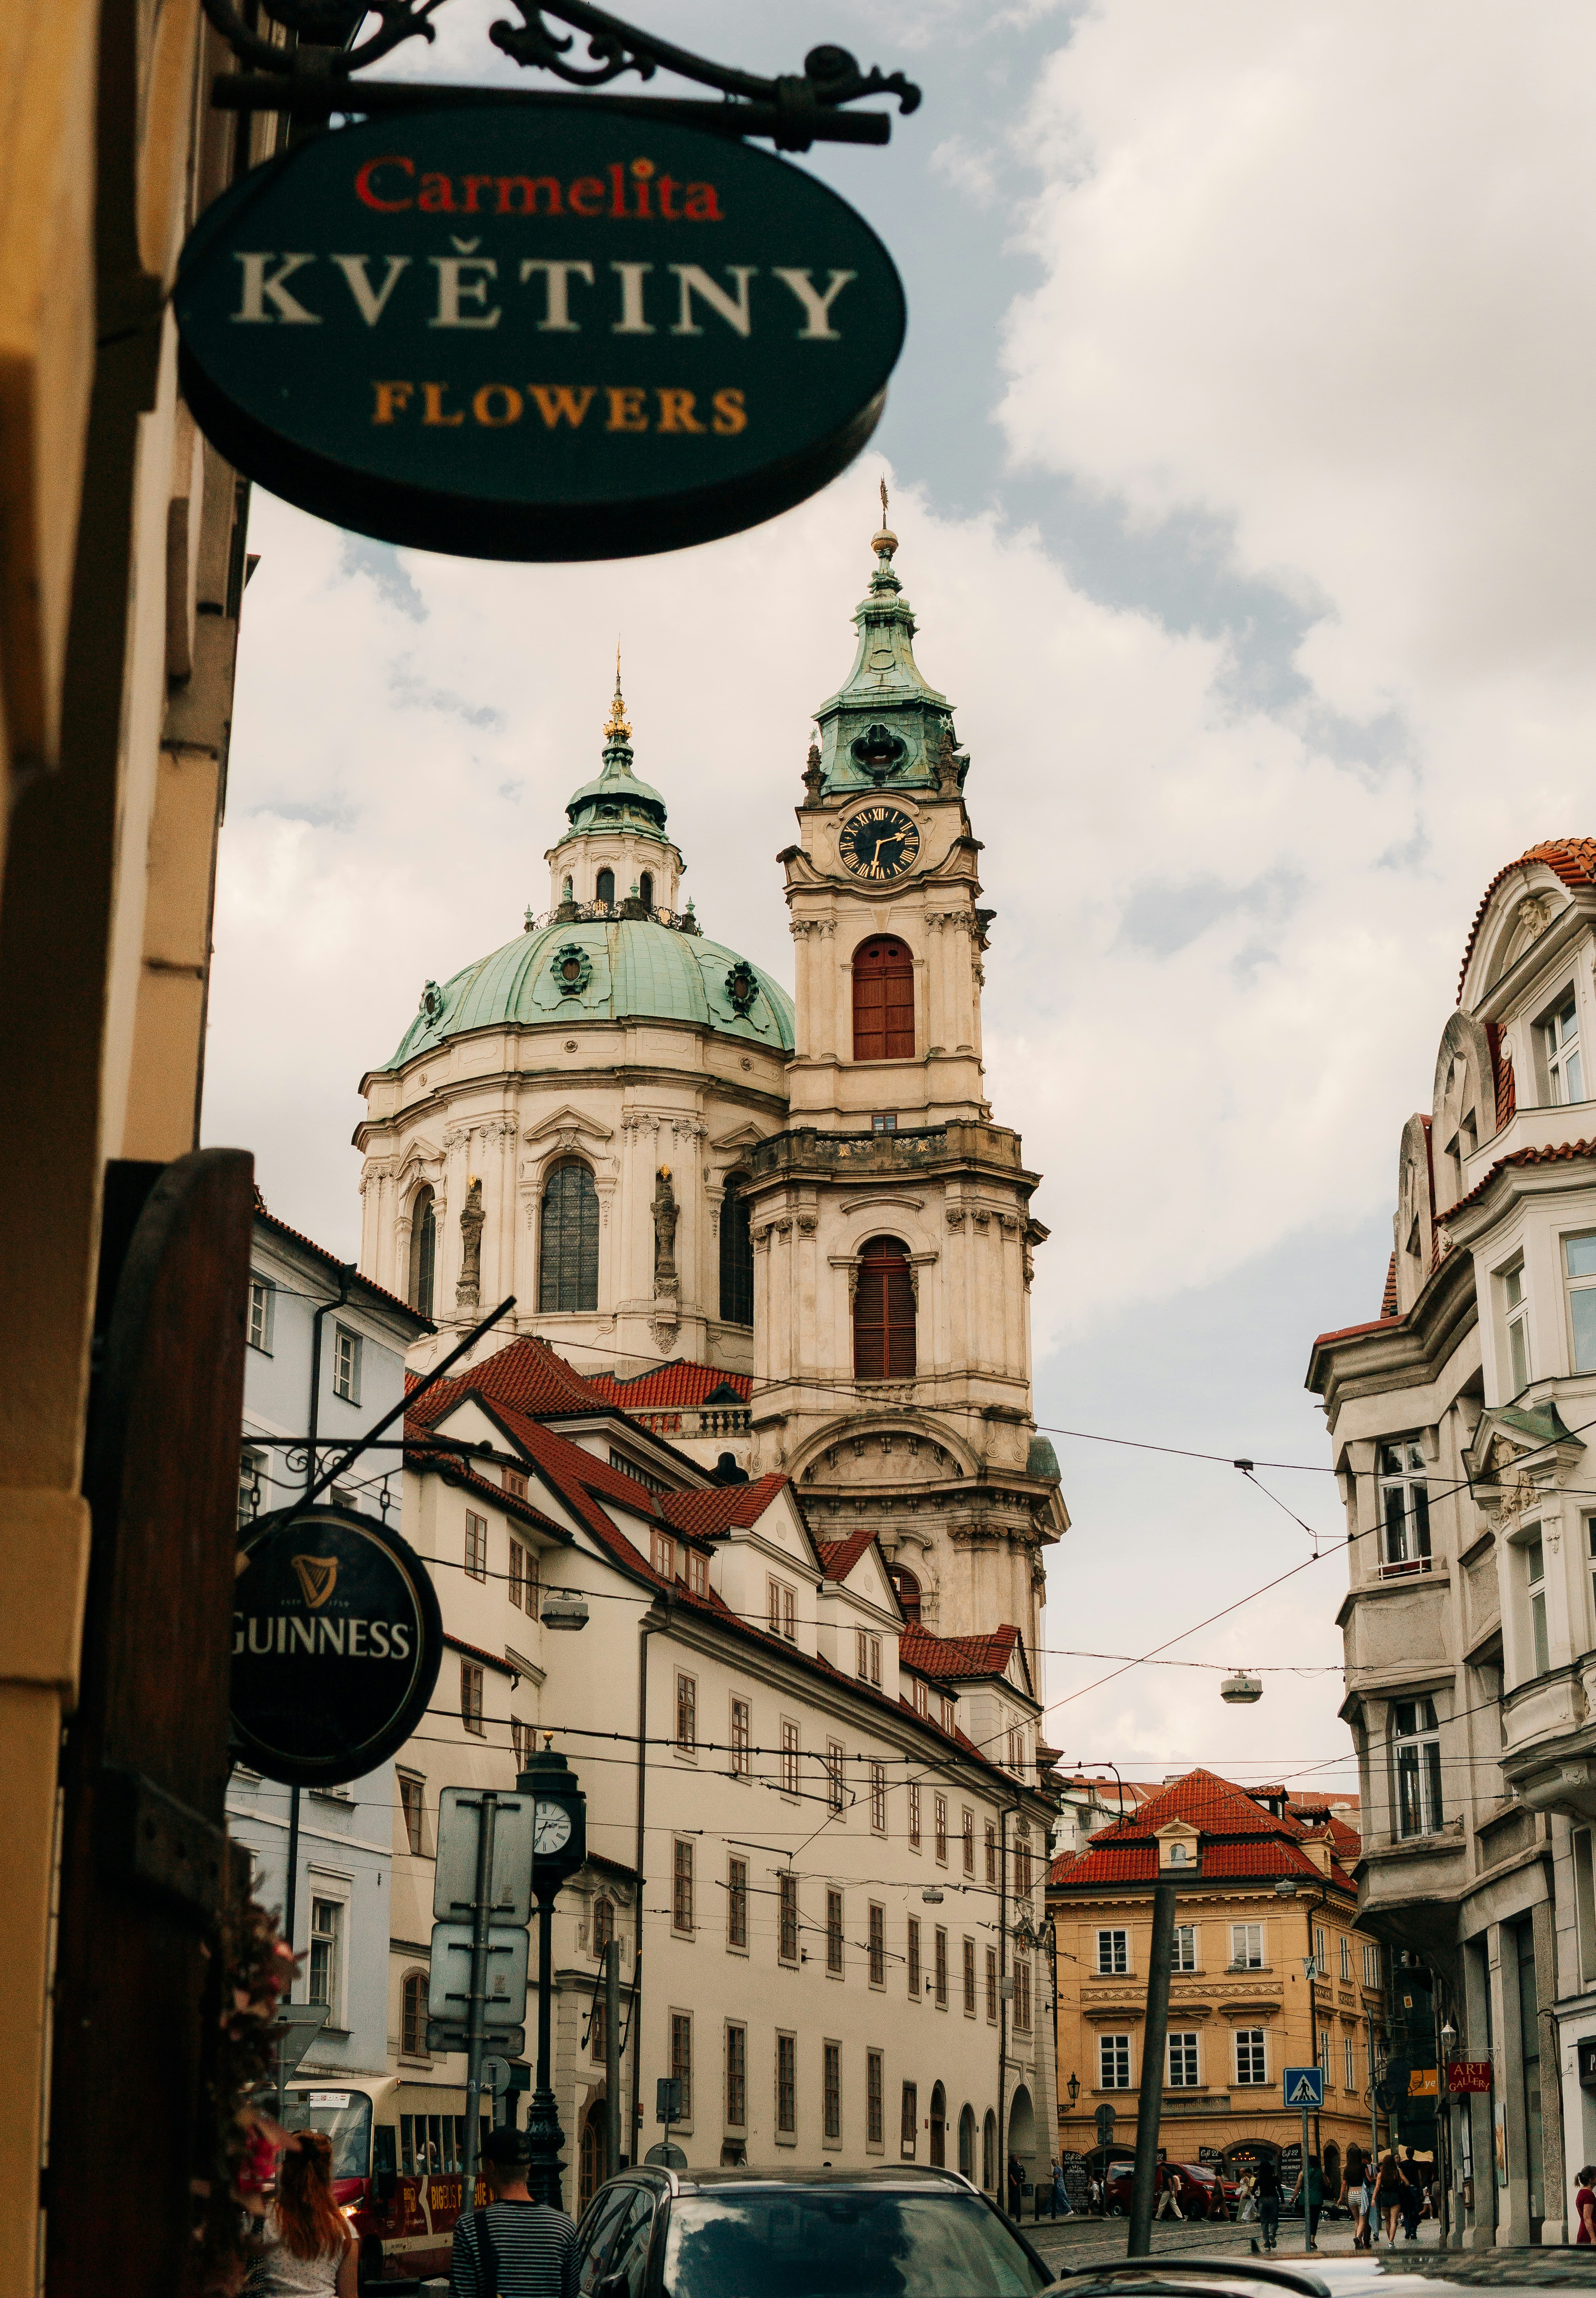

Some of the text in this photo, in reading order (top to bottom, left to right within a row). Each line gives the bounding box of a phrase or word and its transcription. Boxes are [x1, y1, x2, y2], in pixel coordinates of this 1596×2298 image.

[355, 156, 725, 221] Carmelita
[230, 236, 858, 340] KVĚTINY
[370, 380, 748, 436] FLOWERS
[1449, 2075, 1490, 2091] GALLERY
[1454, 2064, 1485, 2074] ART
